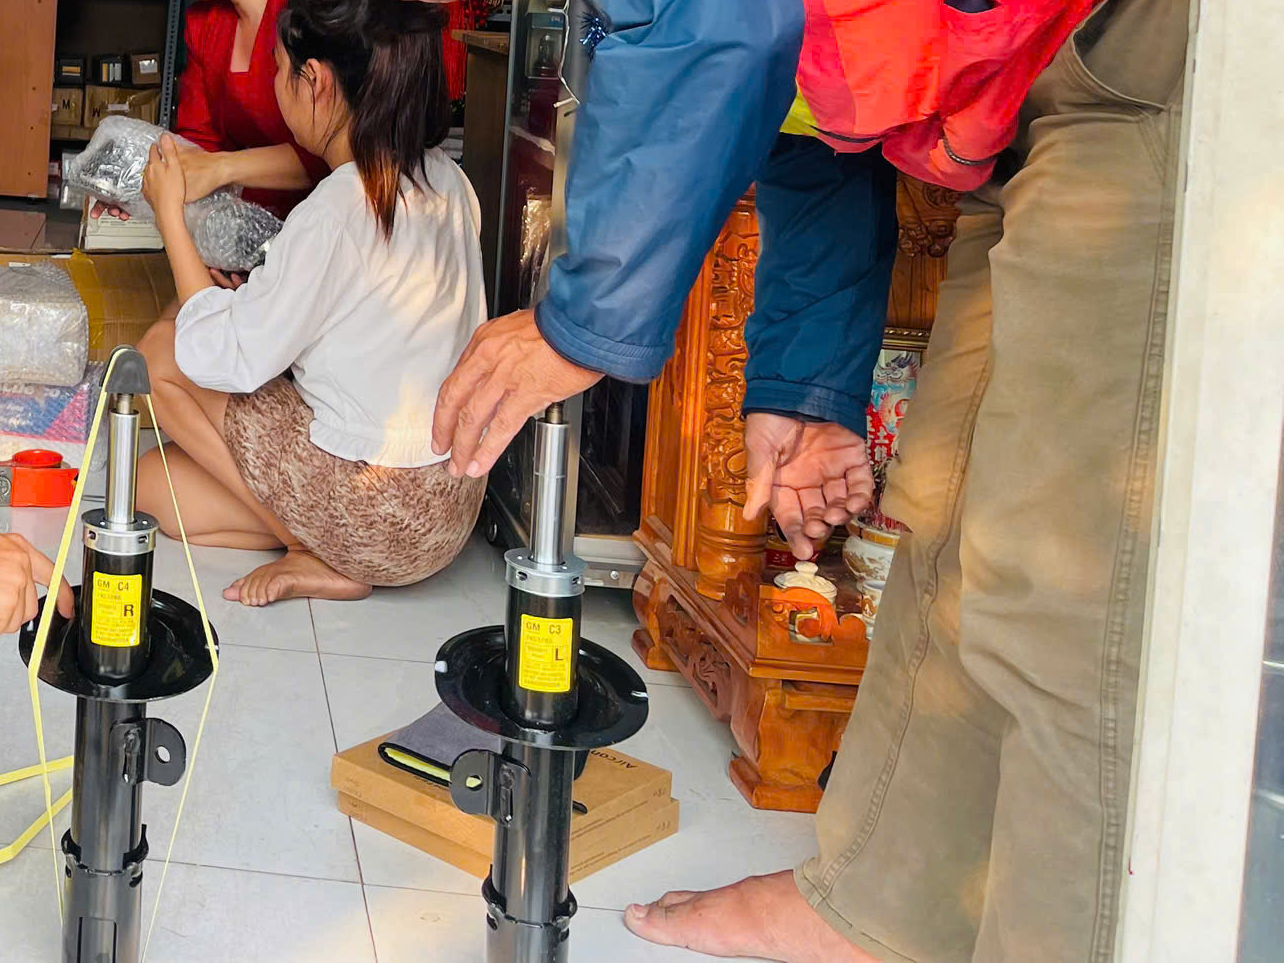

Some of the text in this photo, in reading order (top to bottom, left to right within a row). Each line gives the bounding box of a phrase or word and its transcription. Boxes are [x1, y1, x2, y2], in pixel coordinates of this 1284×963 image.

[97, 580, 129, 591] GM C4
[123, 604, 134, 617] R
[526, 621, 561, 634] GM C3
[555, 648, 564, 661] L
[590, 749, 637, 769] Aircon
